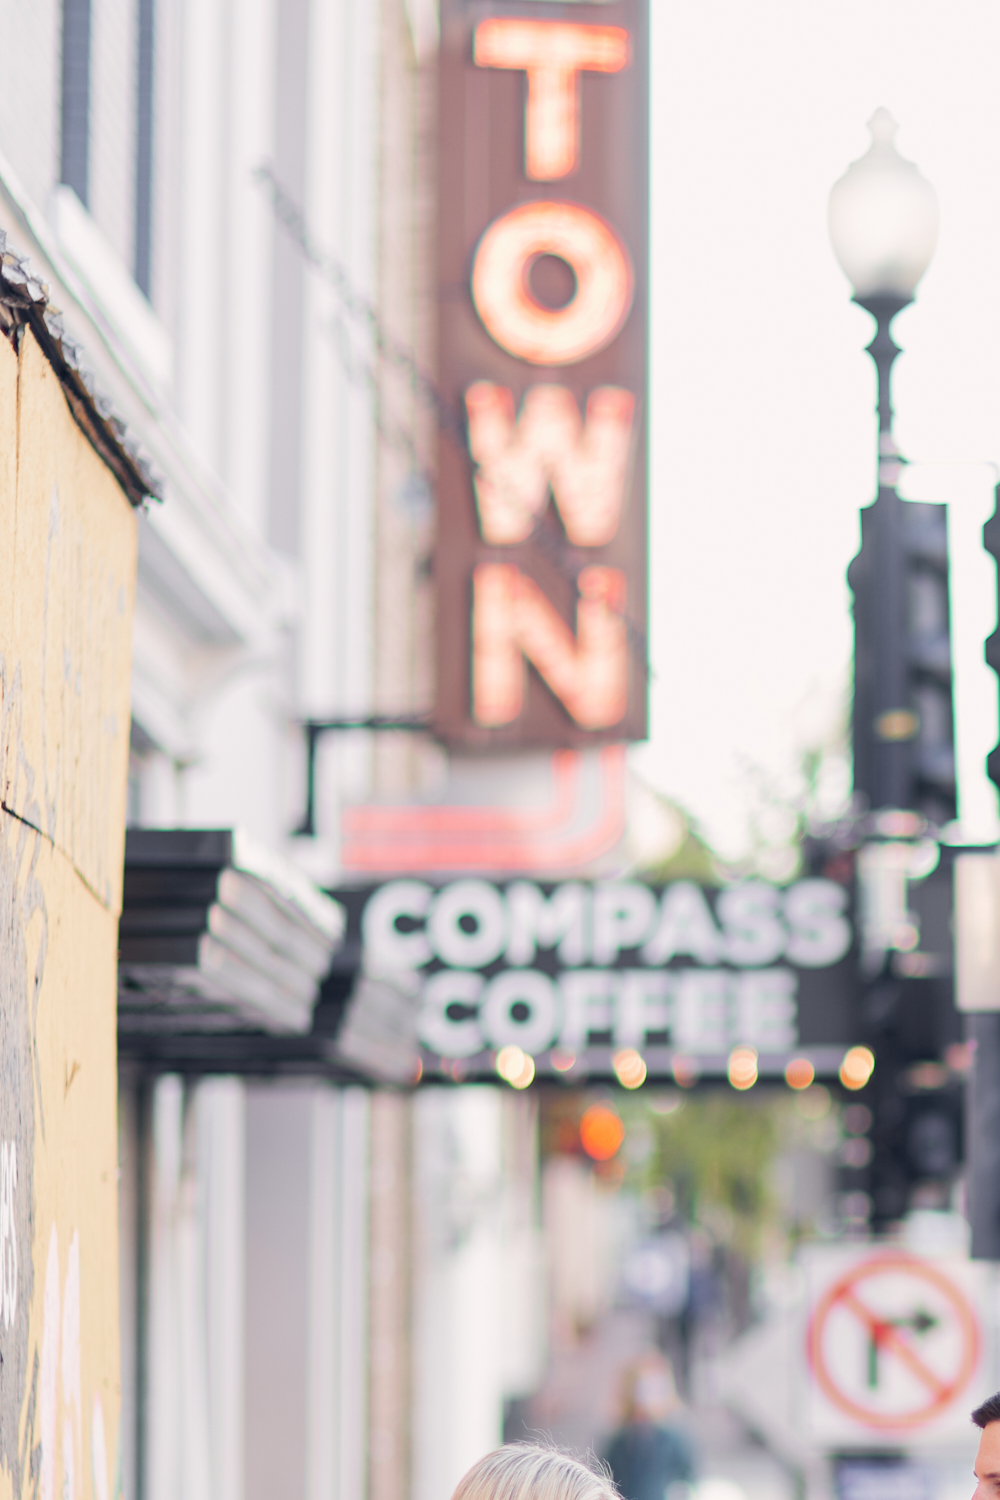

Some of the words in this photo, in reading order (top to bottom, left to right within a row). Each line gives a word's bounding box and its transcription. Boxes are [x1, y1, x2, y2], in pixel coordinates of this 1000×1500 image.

[465, 16, 634, 730] TOWN
[361, 877, 850, 970] COMPASS
[416, 967, 799, 1057] COFFEE
